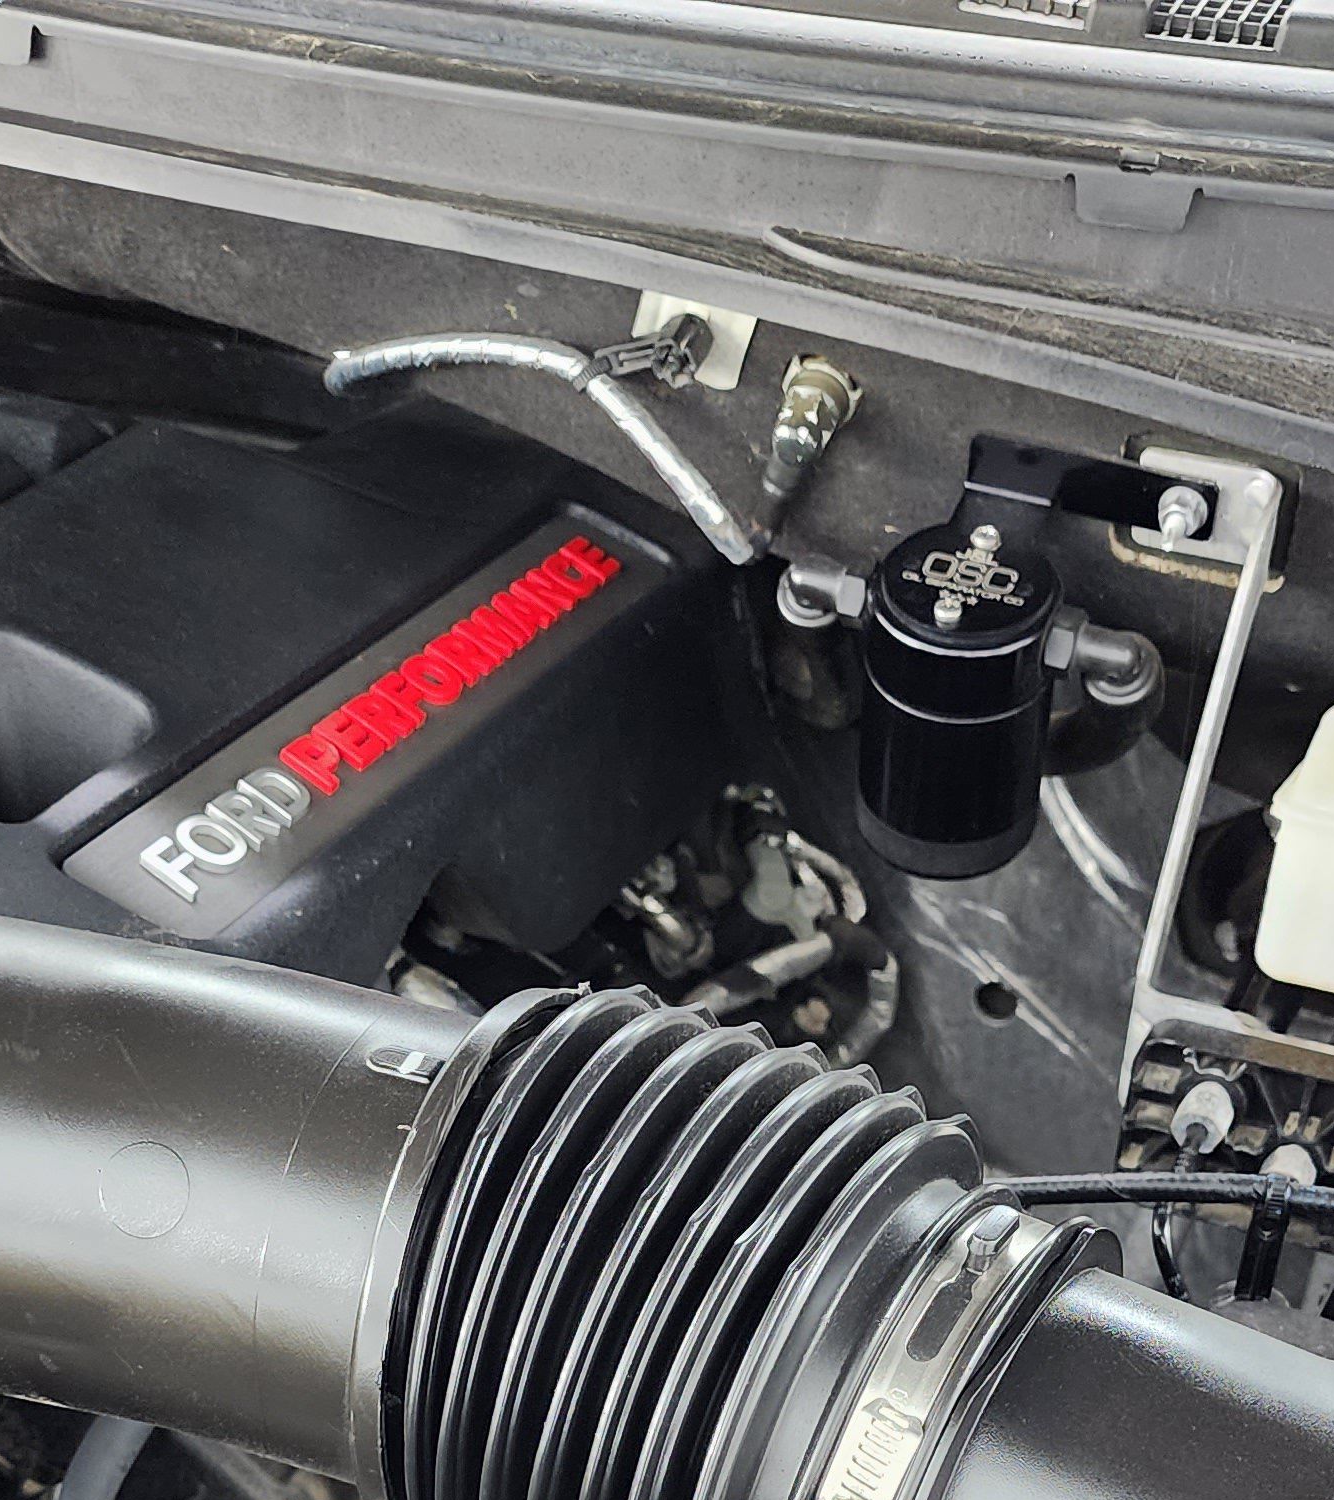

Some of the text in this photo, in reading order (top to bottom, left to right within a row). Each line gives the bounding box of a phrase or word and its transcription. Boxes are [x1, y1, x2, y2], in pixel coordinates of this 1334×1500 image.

[921, 551, 1020, 595] OSC
[139, 535, 622, 903] FORD PERFORMANCE
